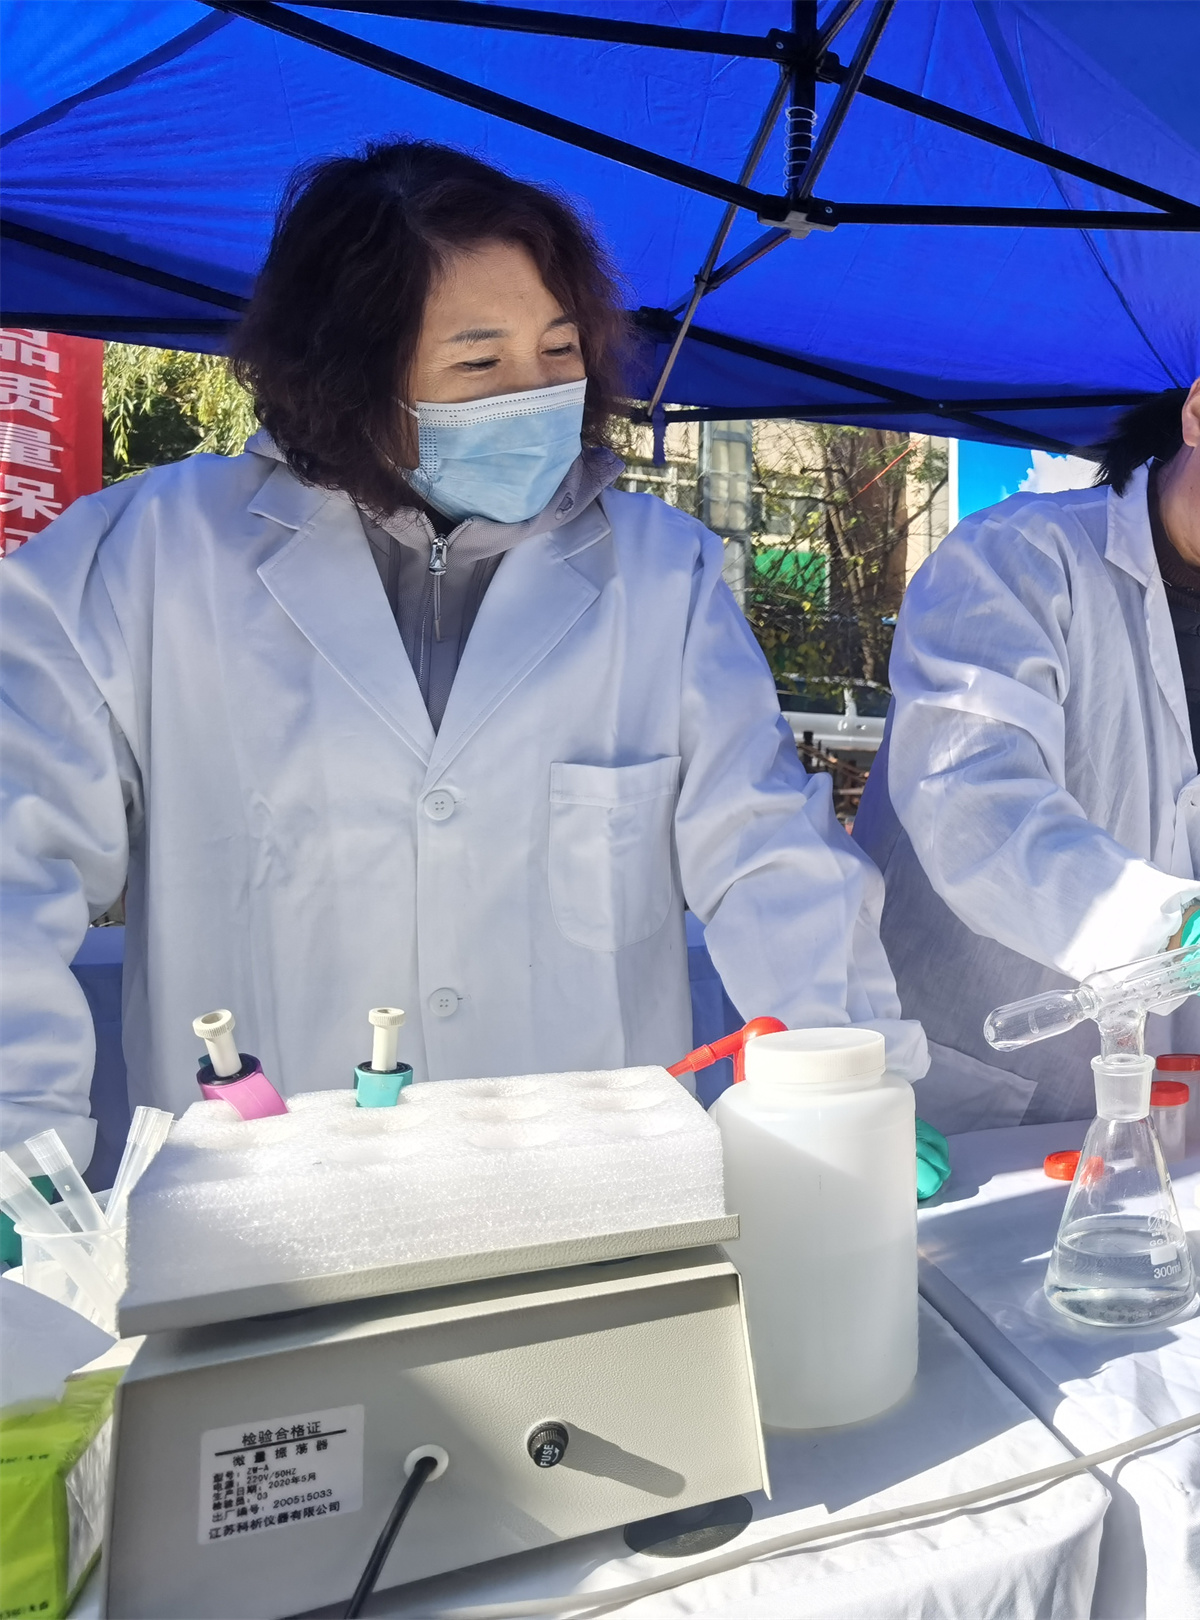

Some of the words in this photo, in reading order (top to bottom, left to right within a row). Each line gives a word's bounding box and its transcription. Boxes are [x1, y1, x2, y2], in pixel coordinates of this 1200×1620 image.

[1153, 1262, 1182, 1279] 300ml
[242, 1421, 321, 1446] 检验合格证
[233, 1439, 328, 1467] 微量振荡器
[540, 1444, 554, 1467] FUSE
[273, 1489, 333, 1509] 200515033
[209, 1501, 340, 1540] 江苏科析仪器有限公司
